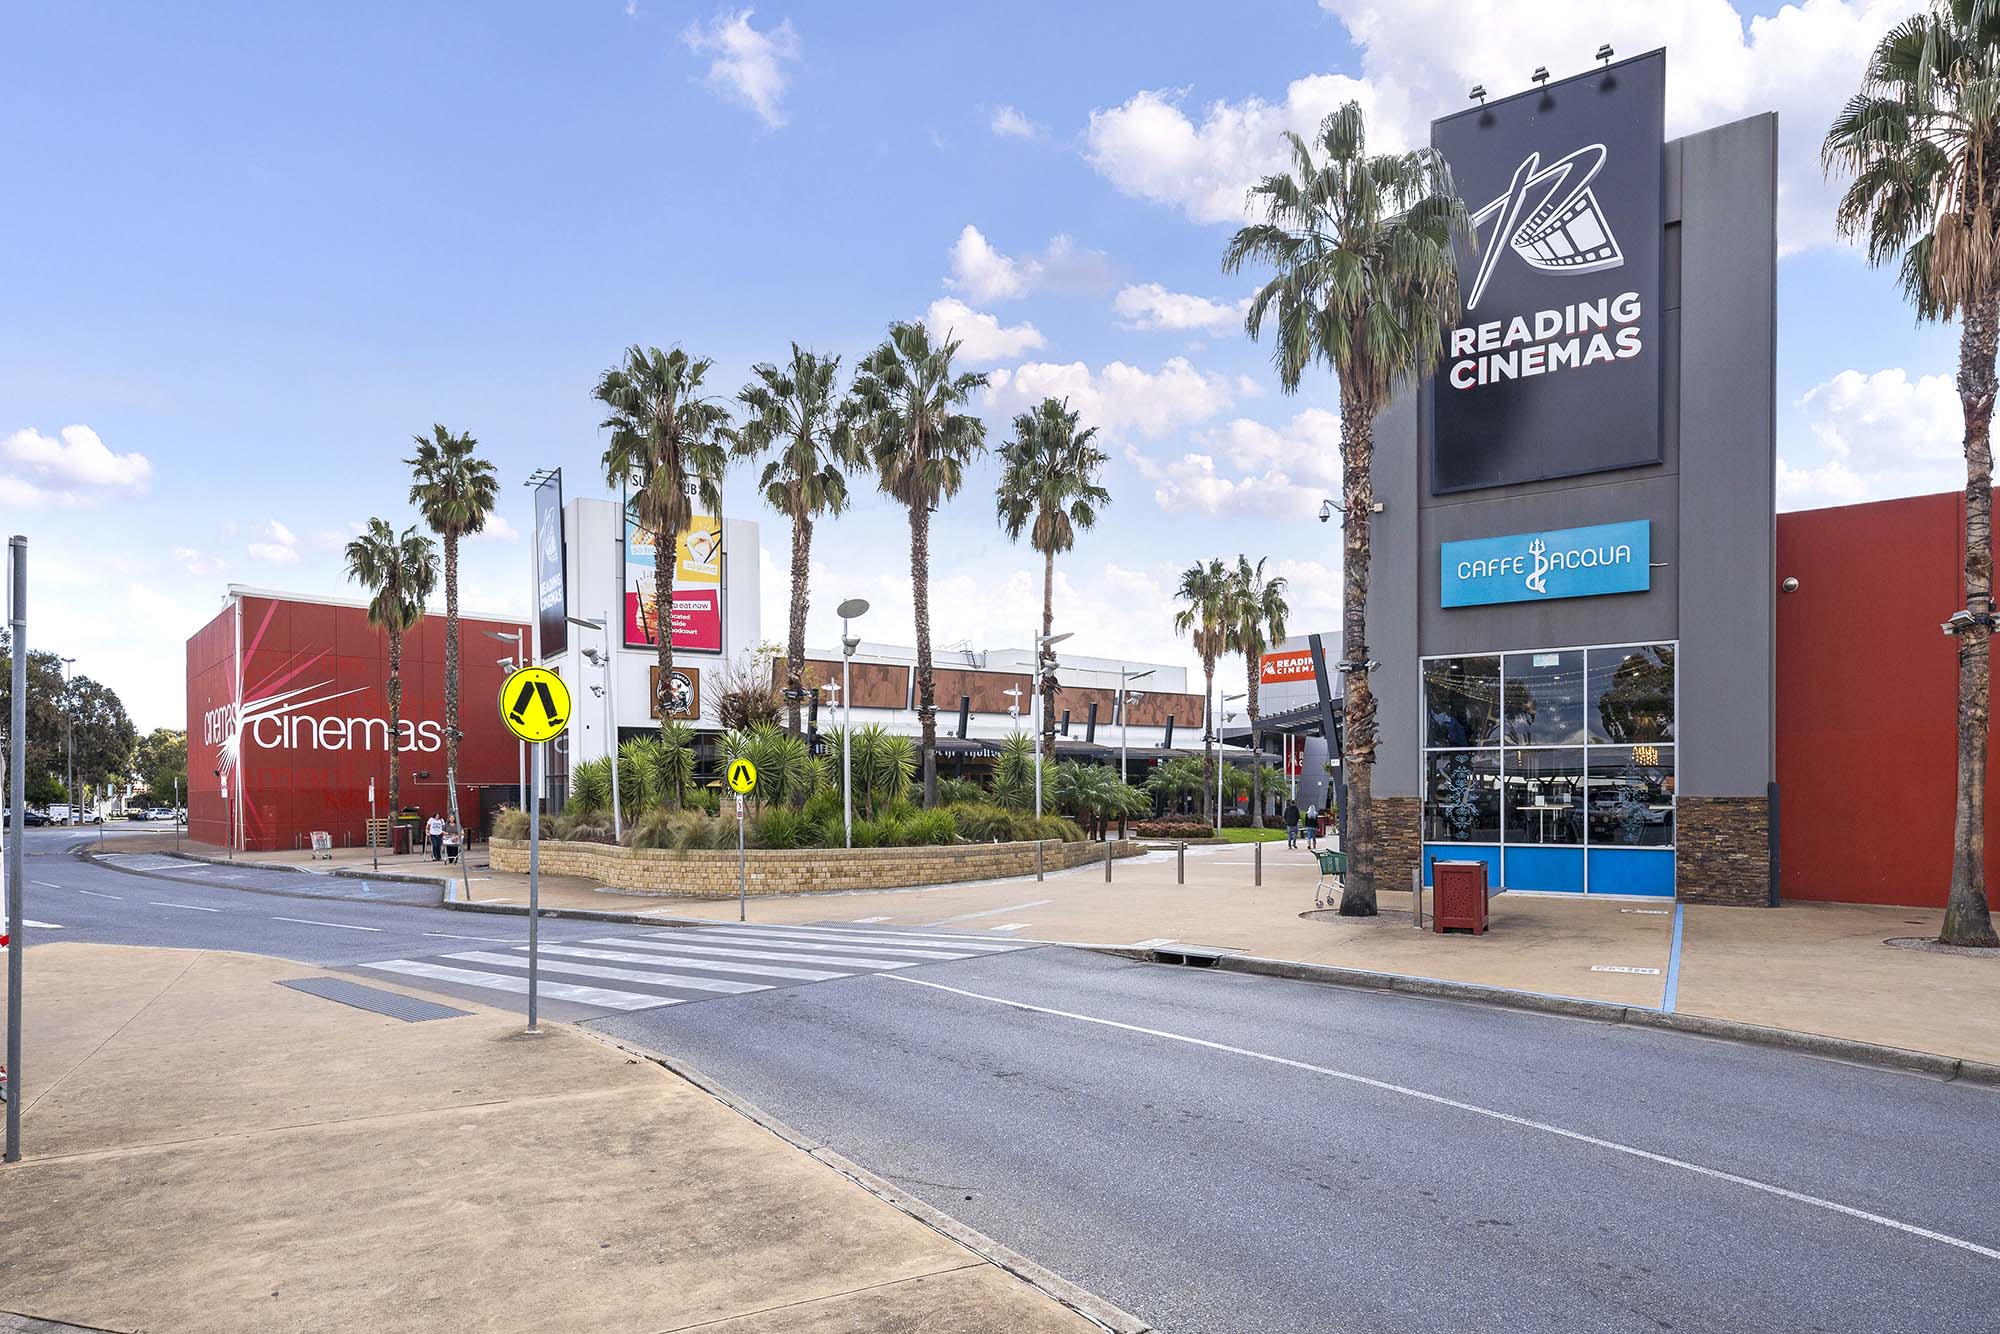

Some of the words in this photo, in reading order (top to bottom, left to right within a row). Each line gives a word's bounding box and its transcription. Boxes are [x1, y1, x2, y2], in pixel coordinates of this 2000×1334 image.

[1450, 292, 1641, 358] READING
[1449, 326, 1642, 390] CINEMAS
[1457, 556, 1525, 580] CAFFE
[671, 613, 691, 621] ocated
[671, 628, 698, 636] oodcourt
[1276, 656, 1314, 668] READIN
[252, 703, 442, 752] cinemas
